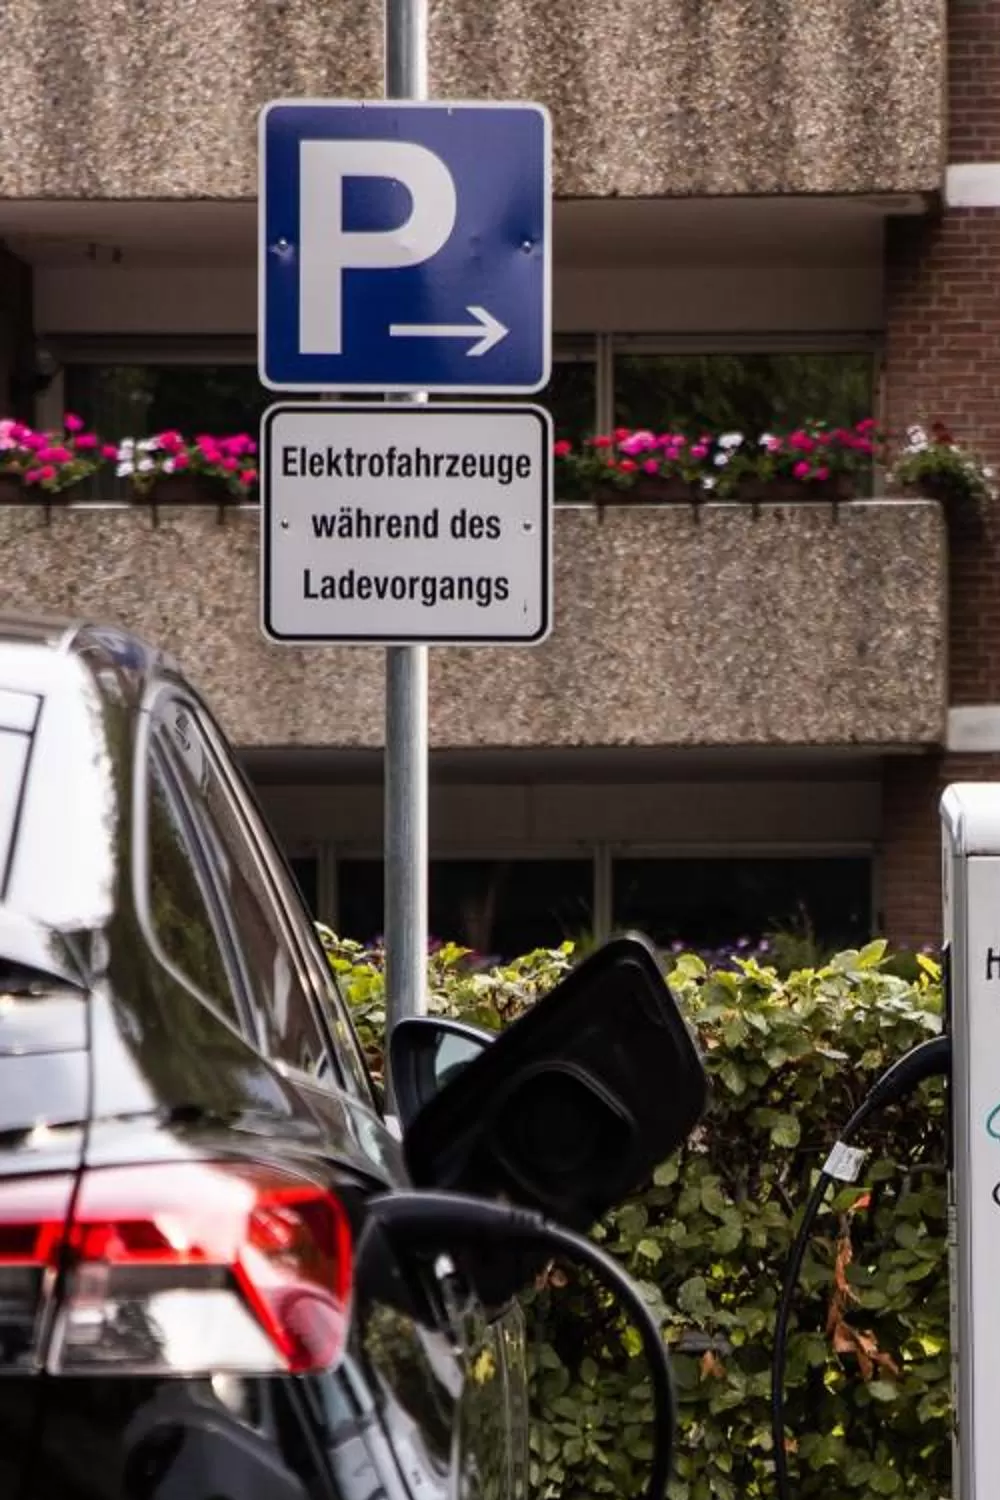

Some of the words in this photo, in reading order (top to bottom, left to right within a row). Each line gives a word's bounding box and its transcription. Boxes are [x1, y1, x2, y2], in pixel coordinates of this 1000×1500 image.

[299, 139, 457, 355] P
[282, 445, 532, 482] Elektrofahrzeuge
[311, 506, 439, 539] während
[450, 507, 502, 540] des
[303, 568, 510, 608] Ladevorgangs
